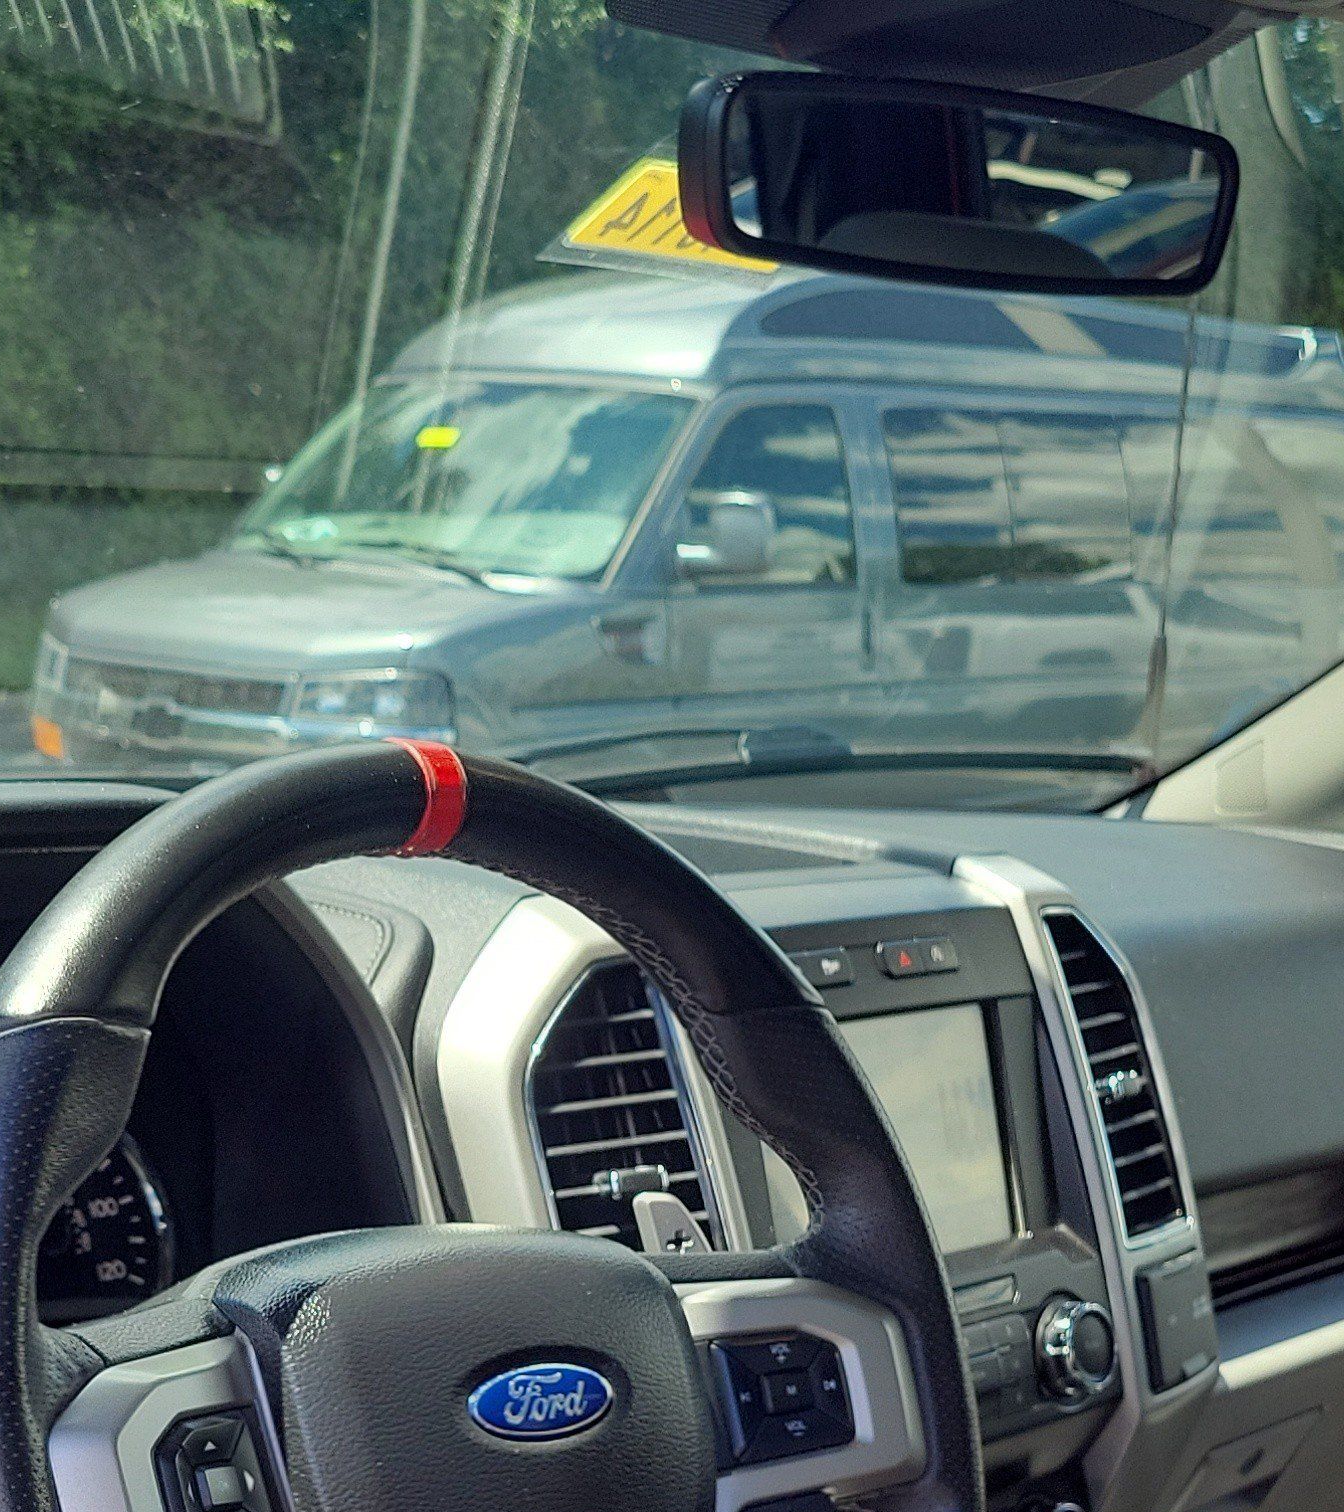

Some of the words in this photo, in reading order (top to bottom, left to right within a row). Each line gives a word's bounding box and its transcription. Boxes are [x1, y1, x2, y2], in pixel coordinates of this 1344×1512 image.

[88, 1195, 119, 1218] 100
[96, 1258, 127, 1281] 120
[503, 1371, 588, 1425] Ford
